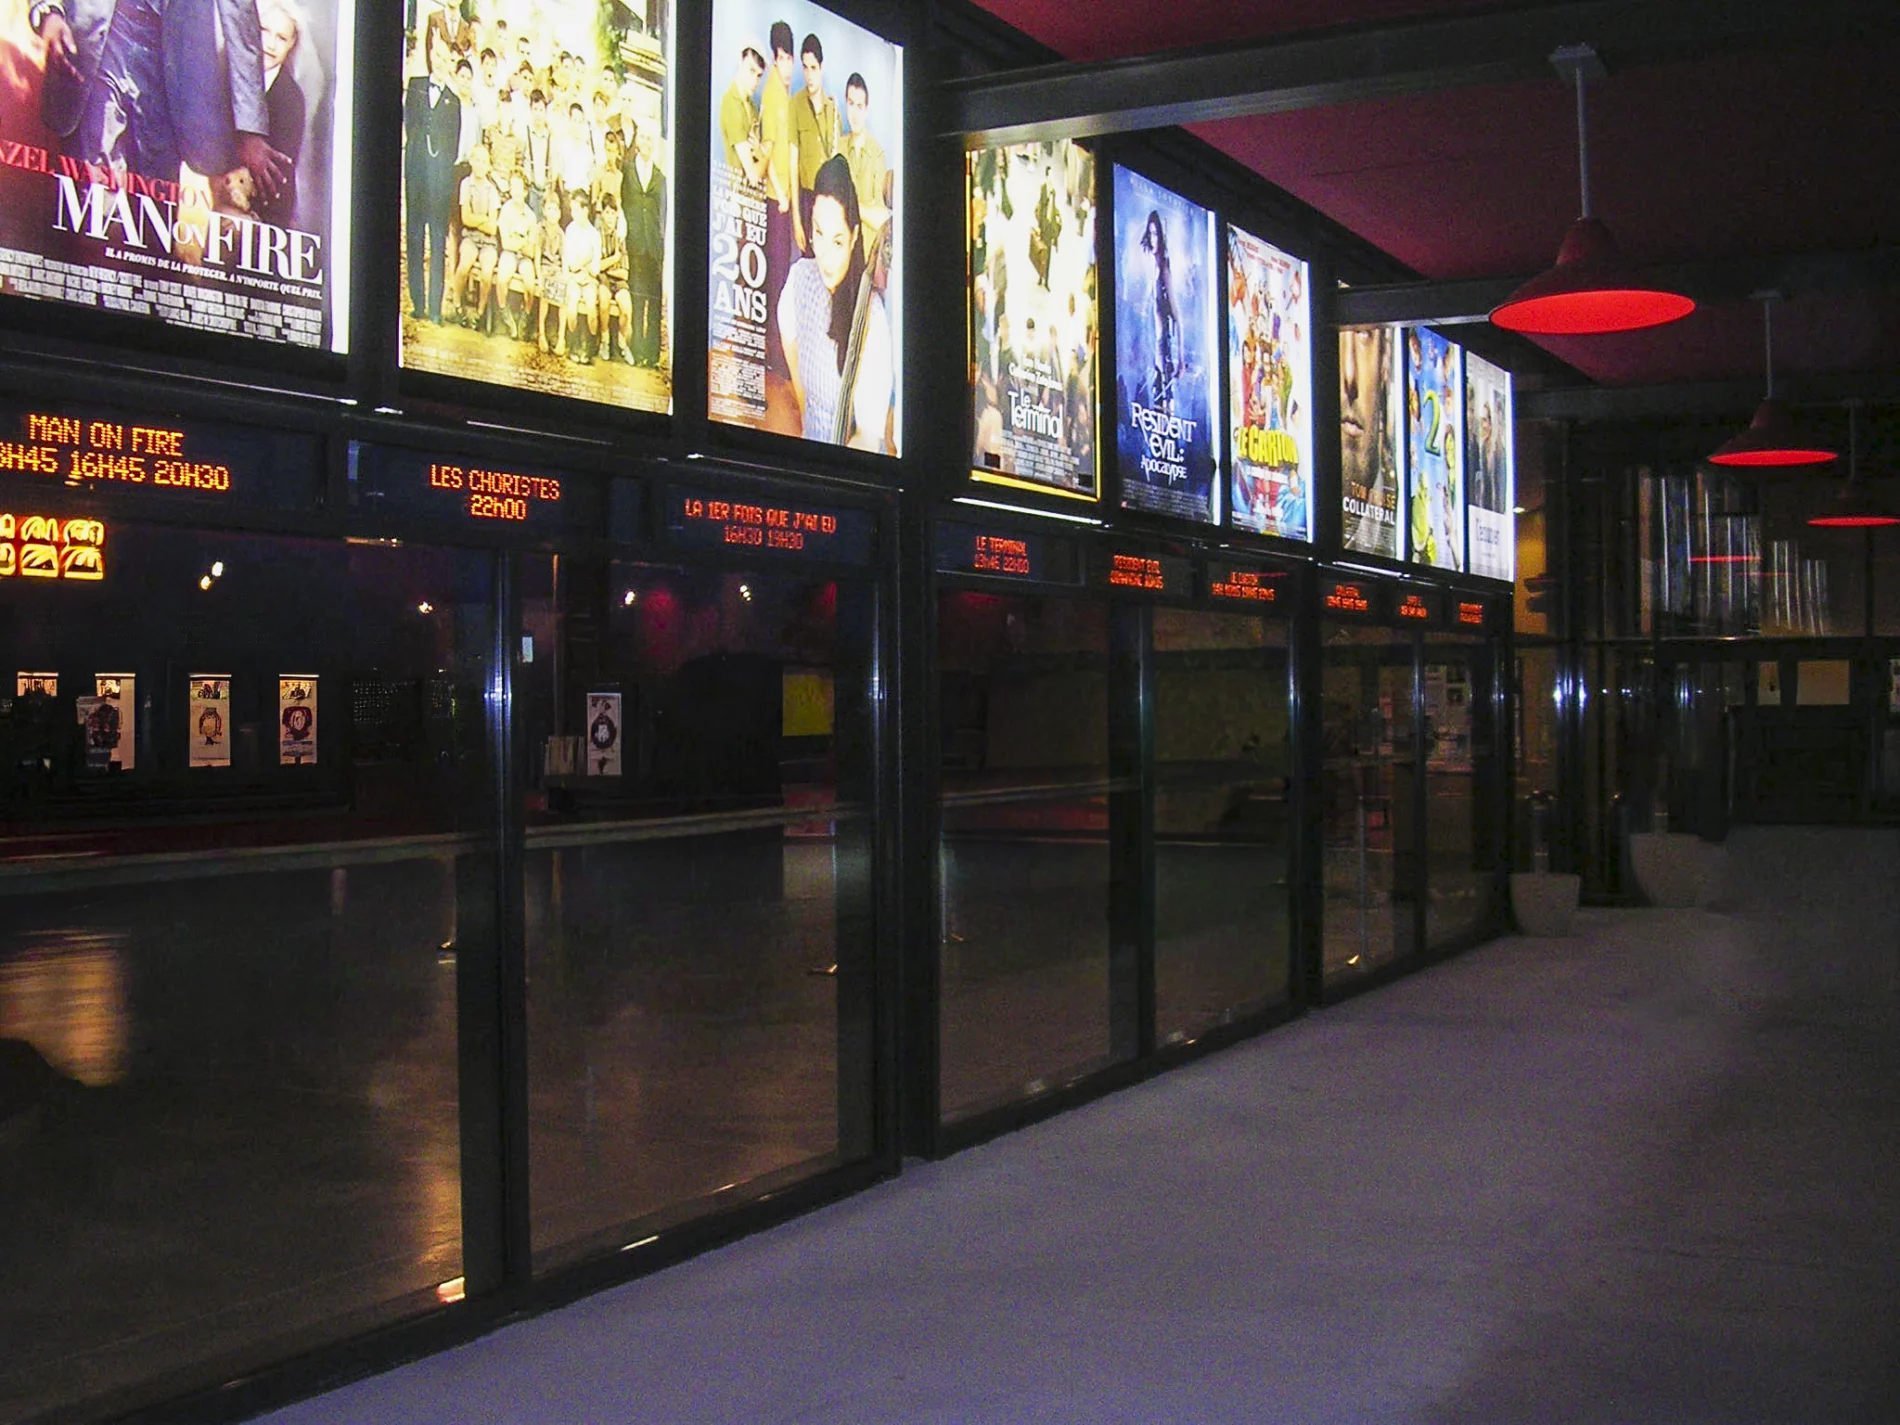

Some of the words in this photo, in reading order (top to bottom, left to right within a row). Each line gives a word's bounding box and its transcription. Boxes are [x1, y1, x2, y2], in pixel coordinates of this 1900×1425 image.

[57, 154, 214, 209] WASHINGTON
[52, 173, 177, 253] MAN
[172, 220, 206, 249] ON
[203, 210, 322, 285] FIRE
[744, 222, 767, 246] EU
[124, 251, 156, 267] PROMIS
[157, 256, 170, 269] DE
[170, 259, 182, 272] LA
[280, 282, 301, 297] QUEL
[712, 232, 767, 288] 20
[714, 279, 767, 323] ANS
[1020, 388, 1031, 409] Le
[29, 413, 81, 445] MAN
[89, 421, 123, 450] ON
[131, 426, 184, 457] FIRE
[69, 449, 146, 483] 16H45
[153, 459, 230, 491] 20H30
[430, 463, 463, 489] LES
[467, 468, 561, 500] CHORISTES
[470, 493, 527, 520] 22h00
[685, 498, 703, 517] LA
[707, 501, 730, 521] 1ER
[733, 504, 763, 525] FOIS
[766, 508, 790, 528] QUE
[821, 515, 837, 534] EU
[1342, 496, 1396, 526] COLLATERAL
